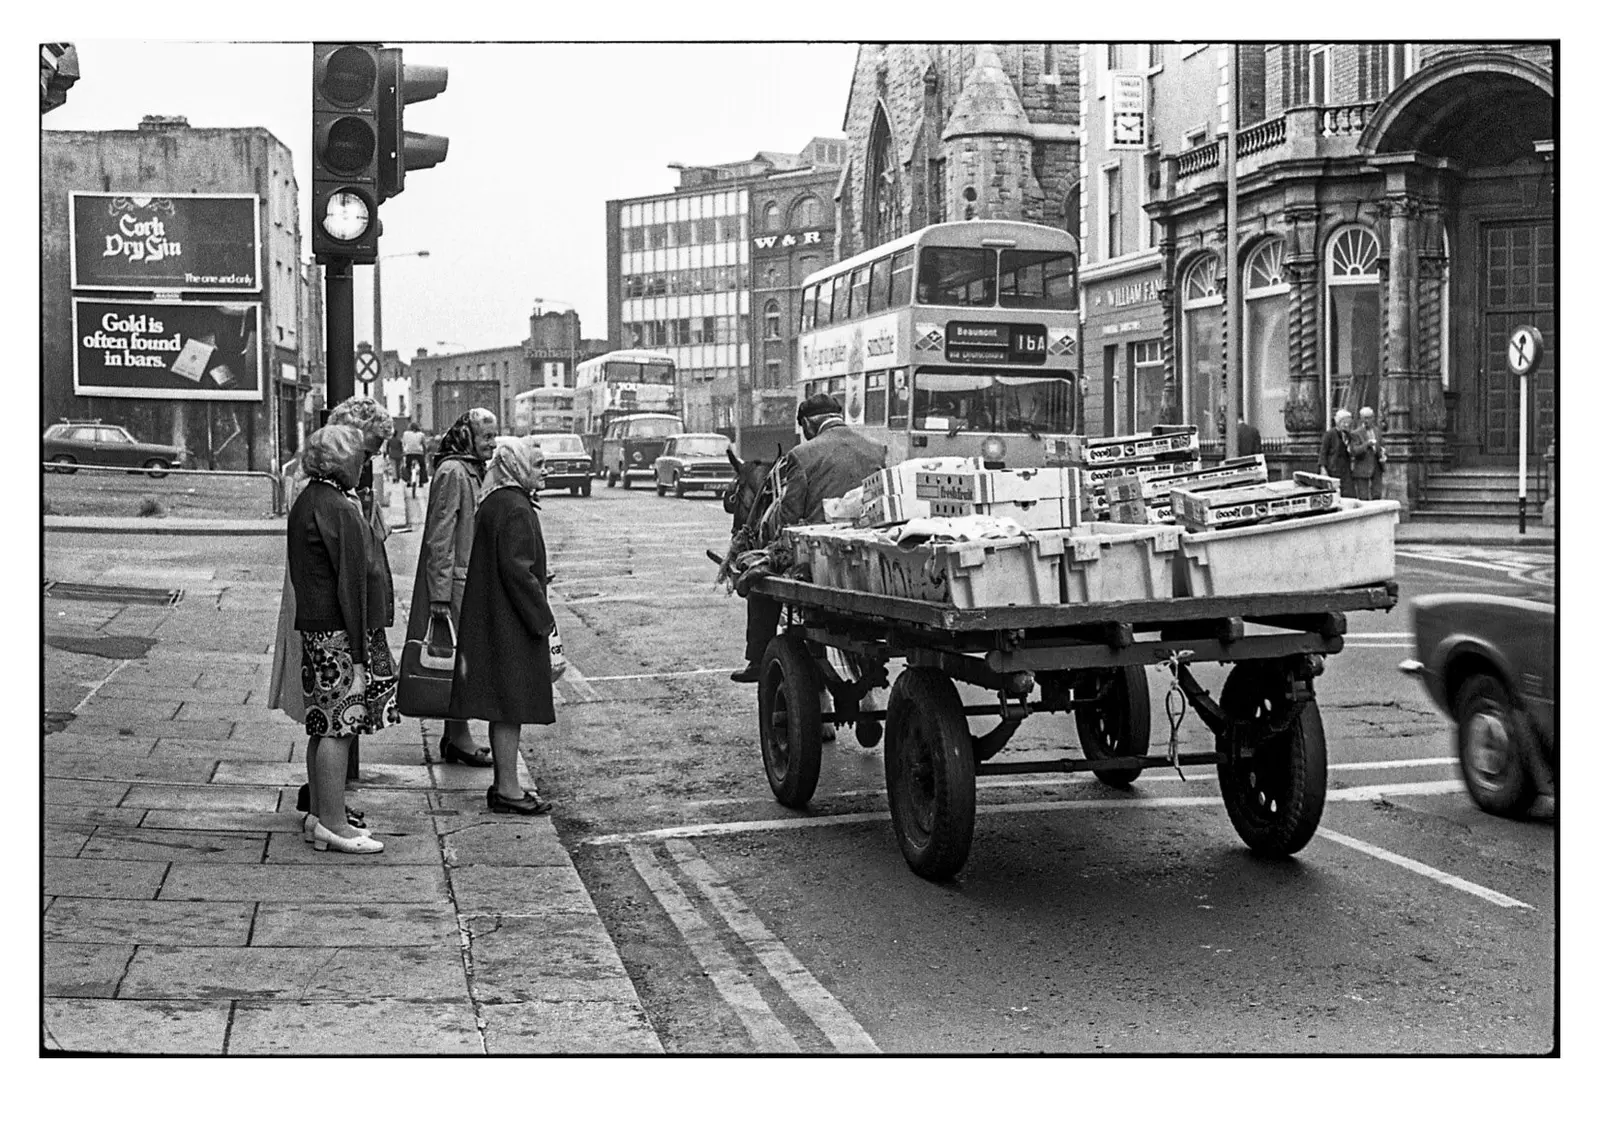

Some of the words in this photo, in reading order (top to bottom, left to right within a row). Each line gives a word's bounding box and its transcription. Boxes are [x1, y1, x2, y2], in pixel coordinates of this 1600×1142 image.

[119, 213, 165, 237] Cork
[103, 233, 144, 263] Dry
[145, 234, 182, 263] Gin
[753, 235, 778, 249] W
[781, 234, 797, 247] &
[803, 231, 822, 245] R
[184, 272, 201, 284] The
[201, 275, 218, 284] one
[218, 272, 236, 284] and
[236, 273, 254, 286] only
[102, 312, 147, 333] Gold
[148, 317, 164, 334] is
[956, 326, 998, 338] Beaumont
[83, 330, 128, 350] often
[130, 332, 182, 352] found
[1018, 334, 1046, 351] 16A
[104, 351, 122, 367] in
[124, 350, 167, 368] bars.
